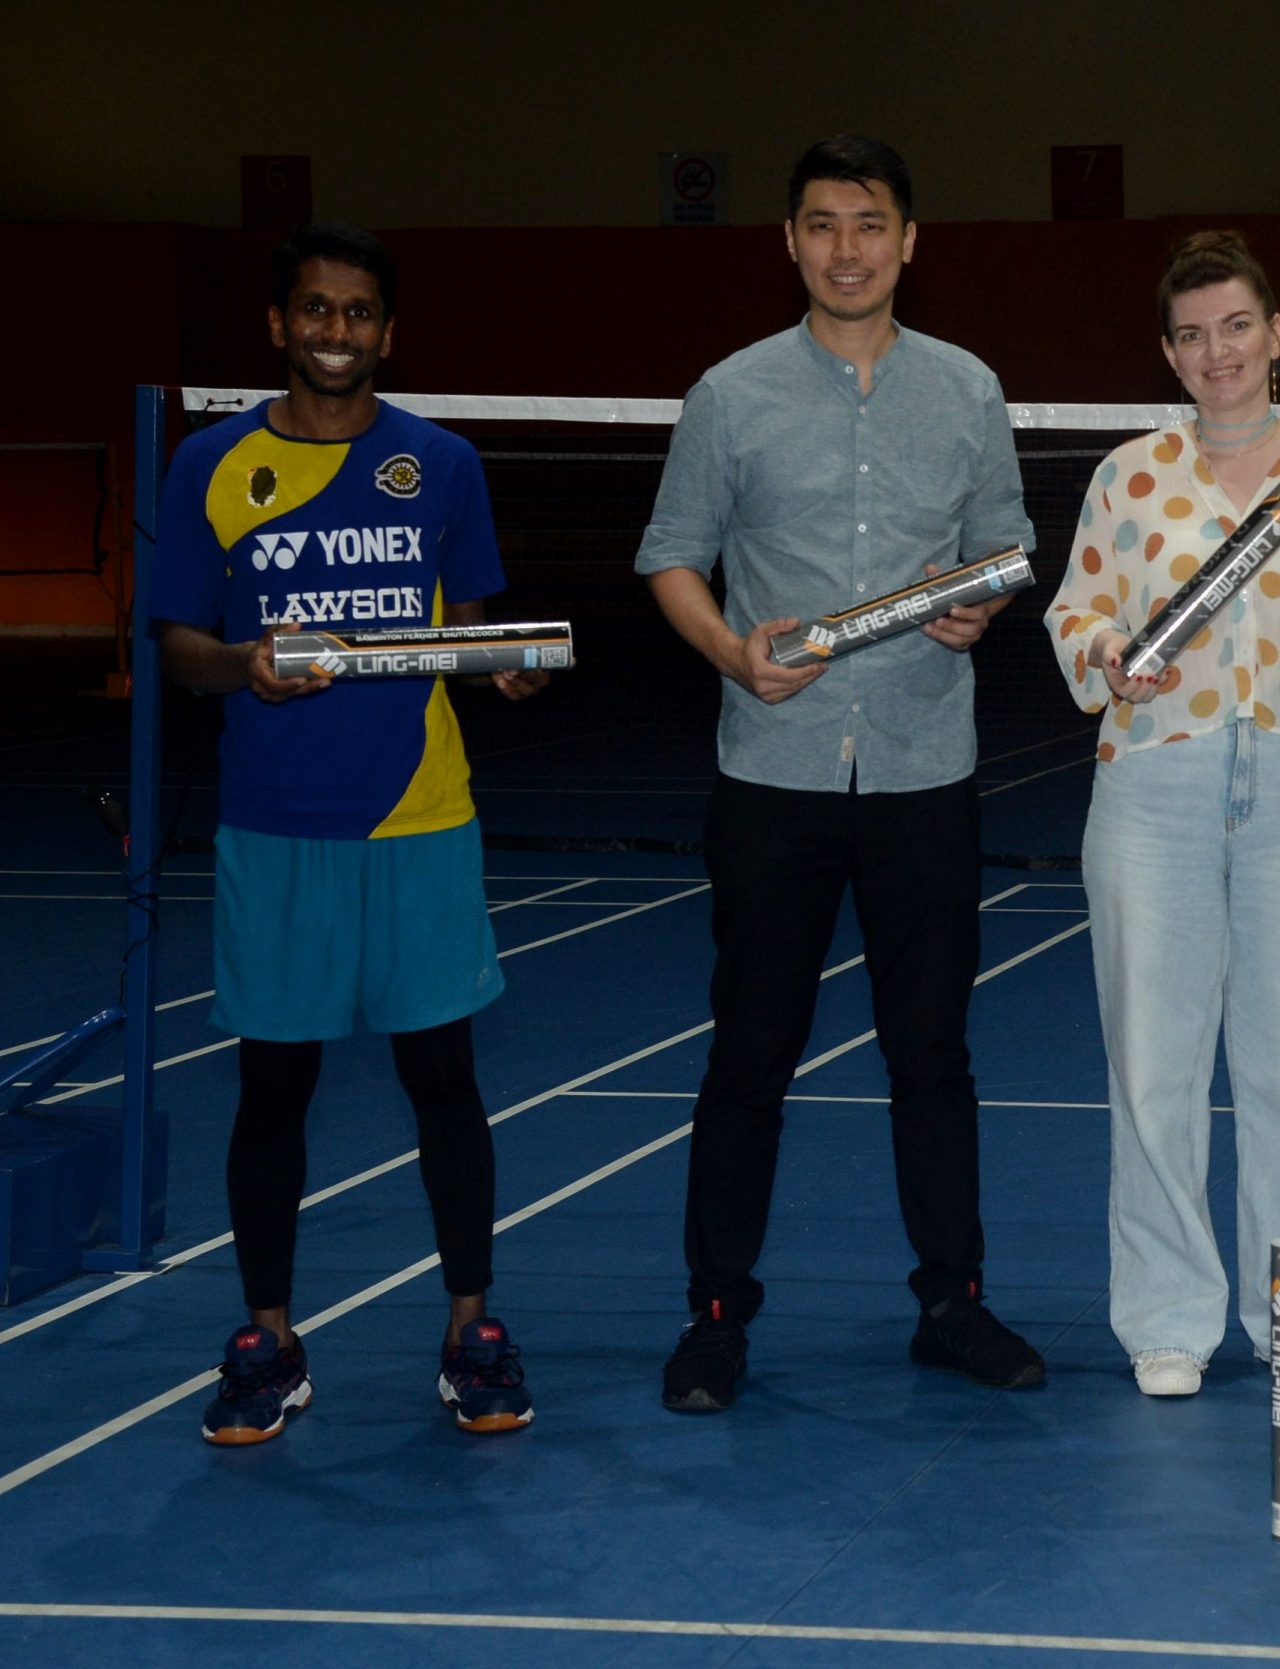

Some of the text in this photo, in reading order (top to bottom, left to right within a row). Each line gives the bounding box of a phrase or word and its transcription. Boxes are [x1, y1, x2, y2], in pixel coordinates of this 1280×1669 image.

[265, 161, 287, 193] 6
[1074, 150, 1097, 185] 7
[316, 526, 423, 566] YONEX
[1202, 537, 1273, 612] LING-MEI
[258, 586, 424, 625] LAWSON
[841, 592, 933, 640] LING-MEI
[355, 629, 504, 642] BADMINTON FEATHER SHUTTLECOCKS
[356, 652, 458, 674] LING-MEI
